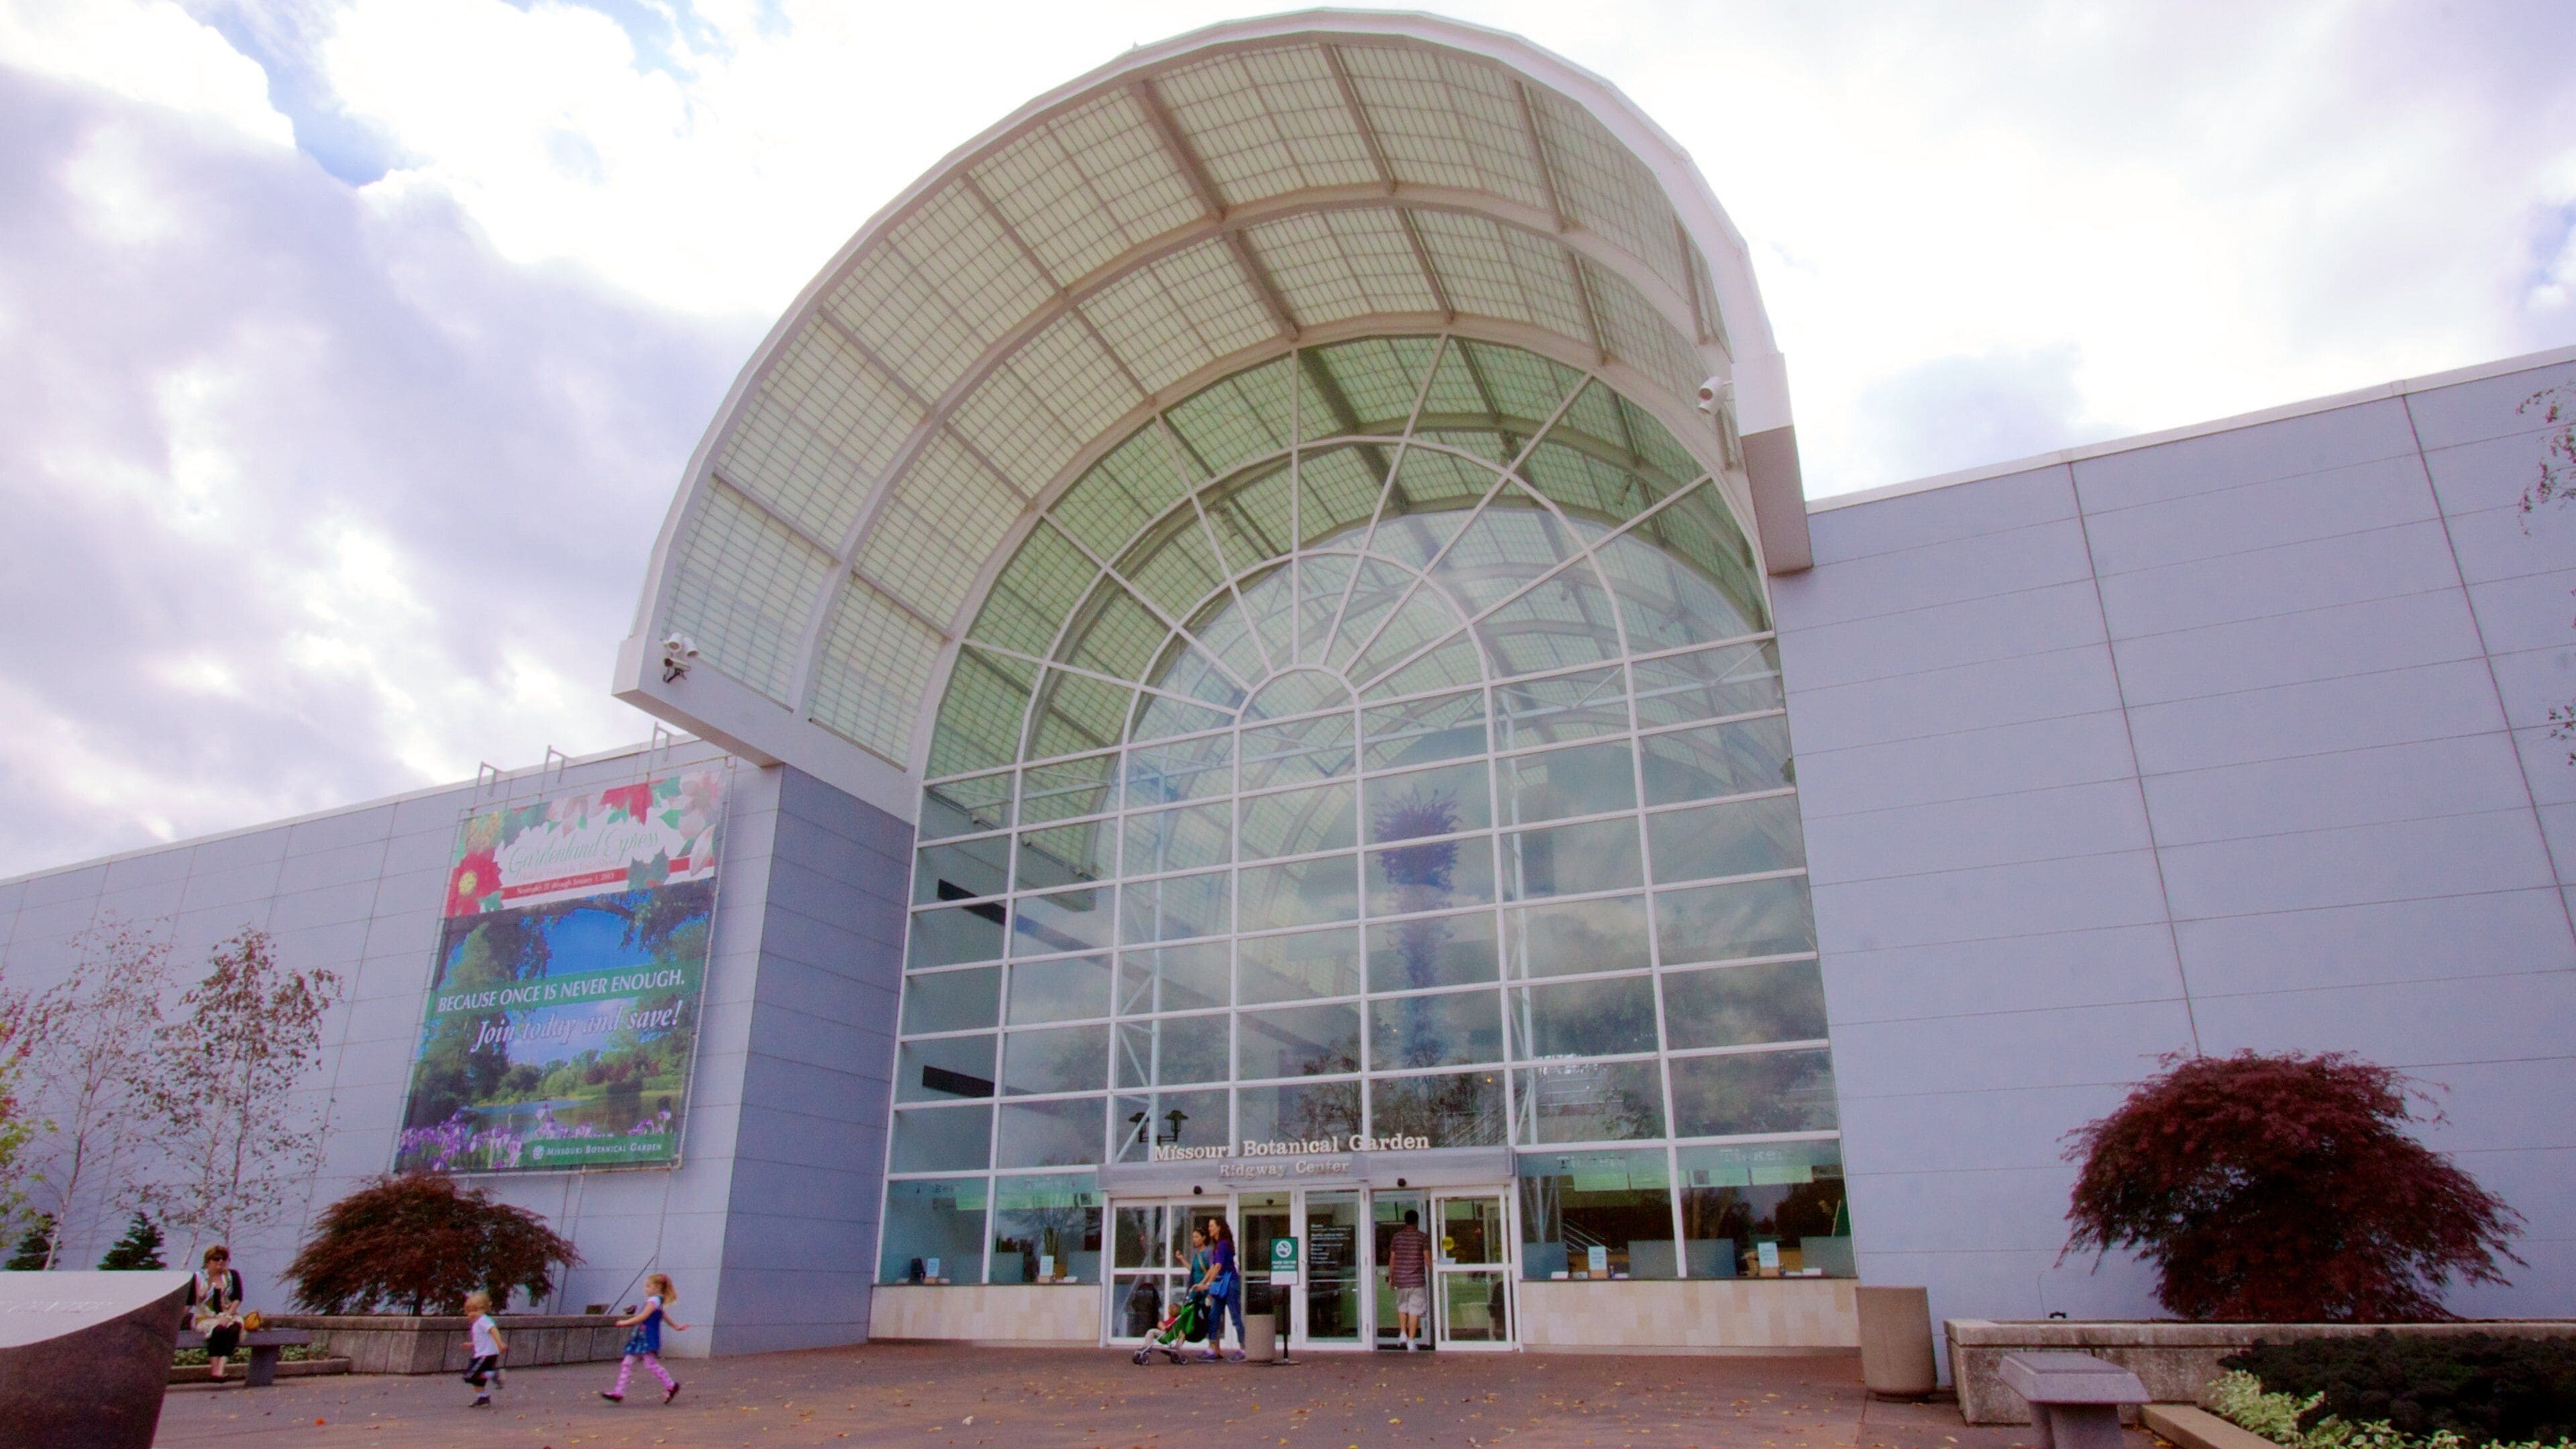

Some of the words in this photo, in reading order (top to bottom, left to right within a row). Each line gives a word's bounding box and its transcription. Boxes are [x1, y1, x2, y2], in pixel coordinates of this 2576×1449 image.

[508, 829, 602, 873] Gardenland
[603, 828, 659, 864] Express
[439, 991, 496, 1012] BECAUSE
[500, 985, 540, 1004] ONCE
[543, 983, 556, 1000] IS
[559, 977, 607, 998] NEVER
[610, 969, 686, 992] ENOUGH.
[470, 1018, 517, 1053] Join
[521, 1013, 576, 1043] today
[581, 1006, 624, 1034] and
[626, 1000, 683, 1029] save!
[1153, 1144, 1236, 1161] Missouri
[1243, 1136, 1340, 1157] Botanical
[1348, 1132, 1430, 1151] Garden
[1220, 1163, 1288, 1179] Ridgway
[1295, 1161, 1350, 1175] Center
